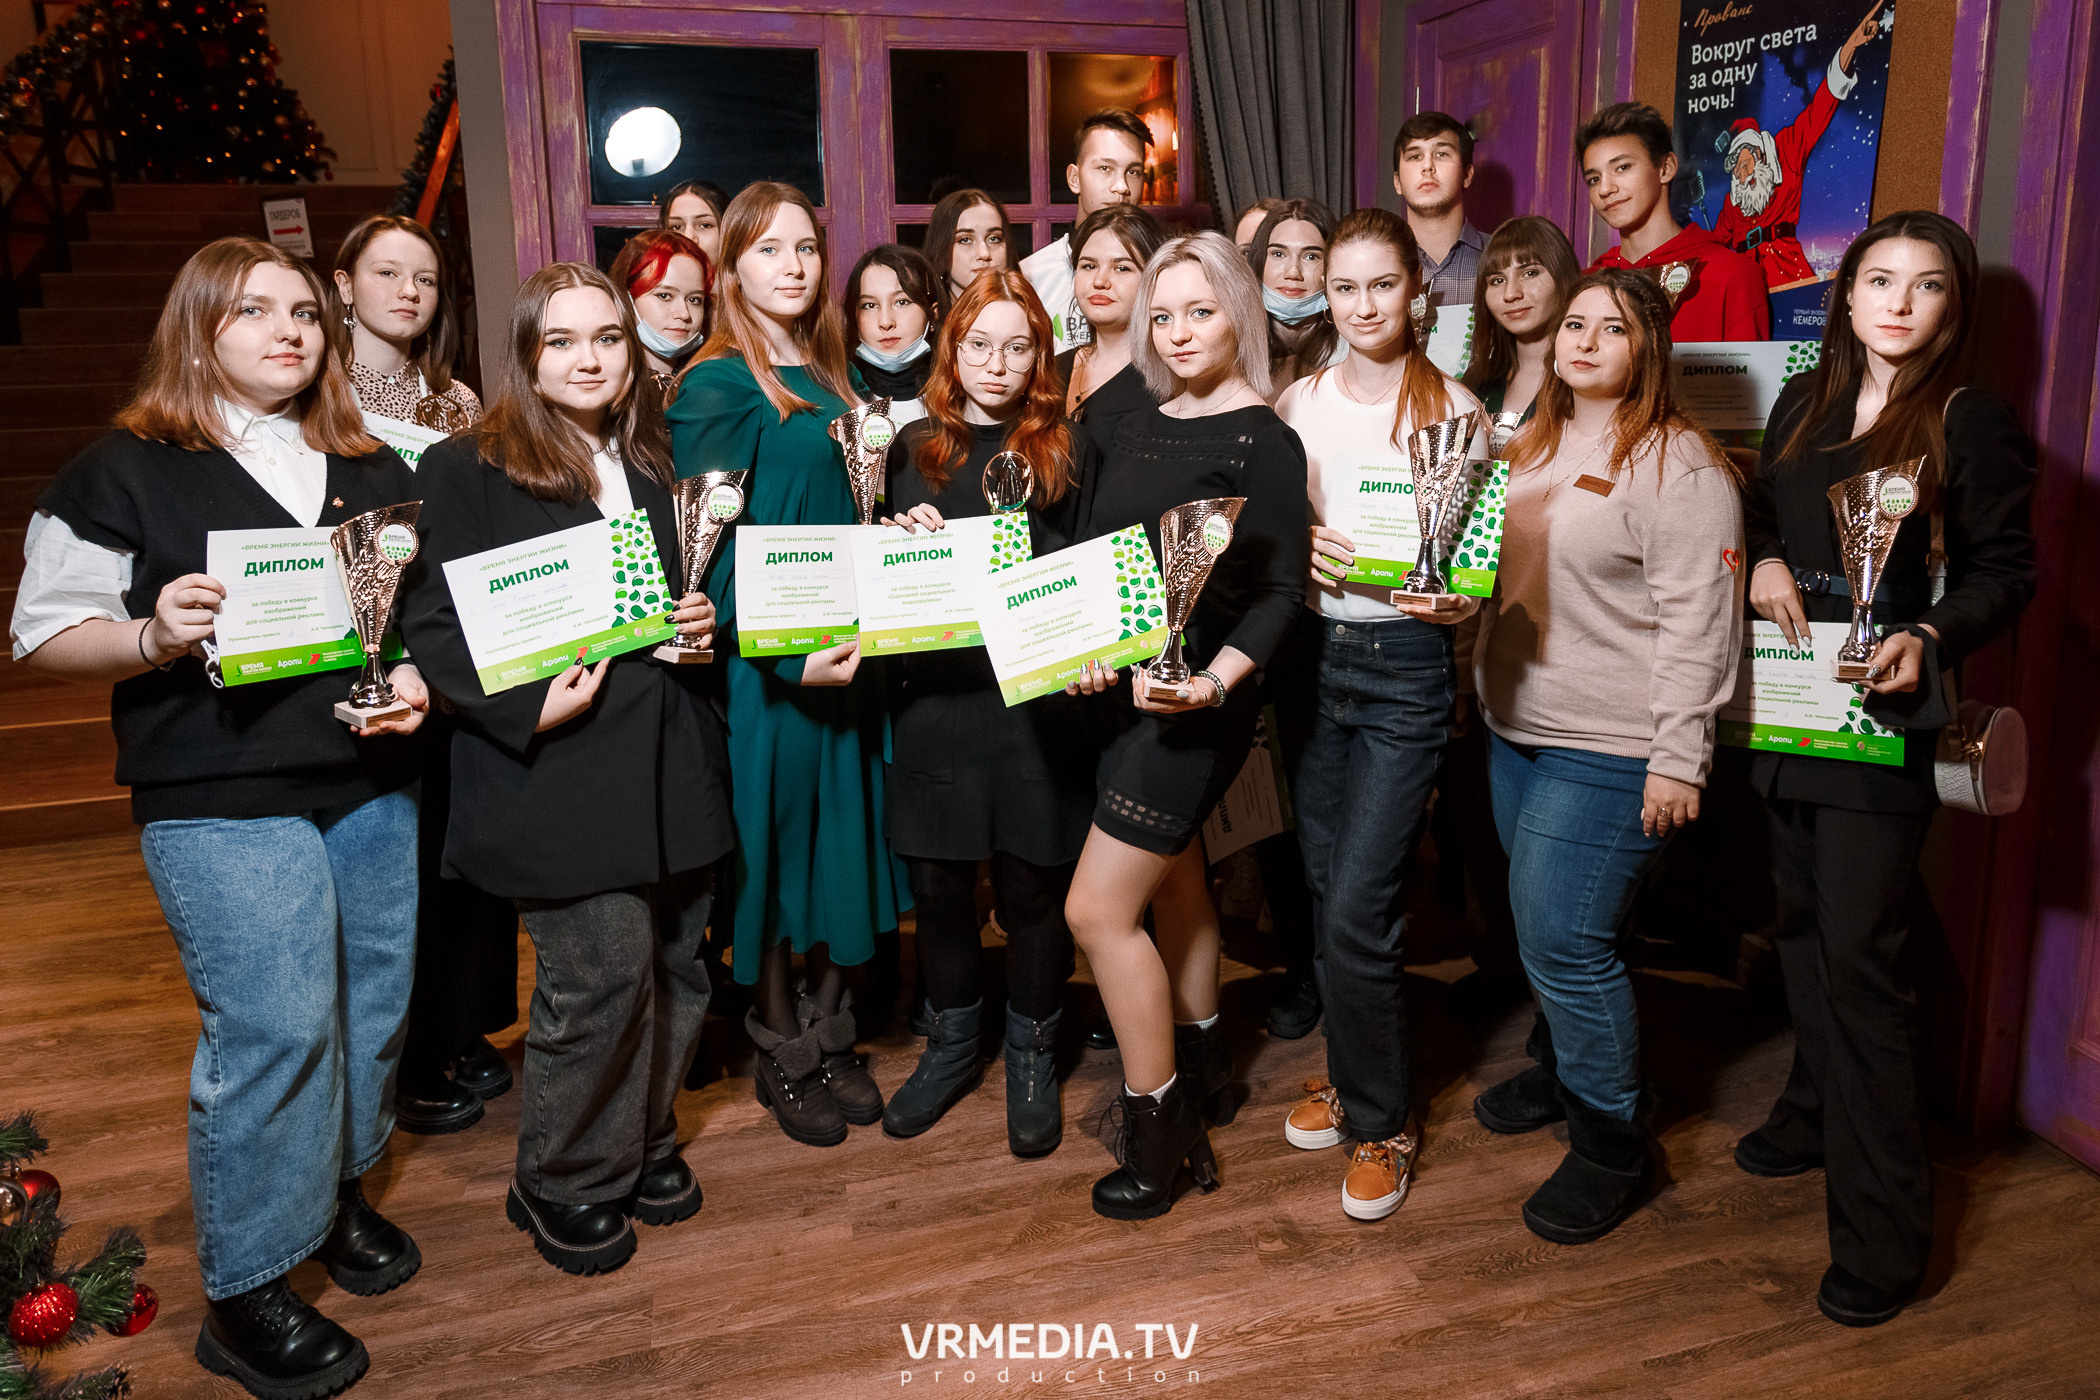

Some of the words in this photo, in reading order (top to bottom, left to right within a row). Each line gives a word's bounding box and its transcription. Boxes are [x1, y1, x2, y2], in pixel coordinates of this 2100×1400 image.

[1694, 1, 1754, 37] Прованс
[1691, 37, 1756, 65] Вокруг
[1760, 23, 1818, 51] света
[1689, 73, 1710, 90] за
[1711, 61, 1758, 88] одну
[1688, 87, 1736, 115] ночь!
[1682, 364, 1748, 377] ДИПЛОМ
[1359, 480, 1414, 495] ДИПЛО
[241, 543, 269, 551] «ВРЕМЯ
[269, 541, 301, 549] ЭНЕРГИИ
[480, 560, 506, 572] «ВРЕМЯ
[507, 551, 538, 564] ЭНЕРГИИ
[539, 543, 567, 555] ЖИЗНИ»
[765, 551, 833, 566] ДИПЛОМ
[883, 547, 953, 567] ДИПЛОМ
[244, 557, 324, 578] ДИПЛОМ
[1370, 568, 1394, 578] Аропи
[489, 558, 570, 594] ДИПЛОМ
[1006, 575, 1078, 610] ДИПЛОМ
[260, 599, 283, 608] победу
[289, 595, 318, 604] конкурсе
[513, 606, 537, 617] победу
[543, 595, 573, 607] конкурсе
[264, 605, 307, 615] изображений
[519, 605, 564, 623] изображений
[259, 614, 297, 624] социальной
[297, 612, 325, 621] рекламы
[516, 616, 555, 632] социальной
[556, 607, 585, 620] рекламы
[790, 637, 815, 646] Аропи
[911, 635, 936, 644] Аропи
[542, 654, 570, 668] Аропи
[1743, 646, 1815, 661] ДИПЛОМ
[240, 661, 264, 671] ВРЕМЯ
[277, 658, 303, 669] Аропи
[1056, 667, 1081, 680] Аропи
[1768, 734, 1793, 744] Аропи
